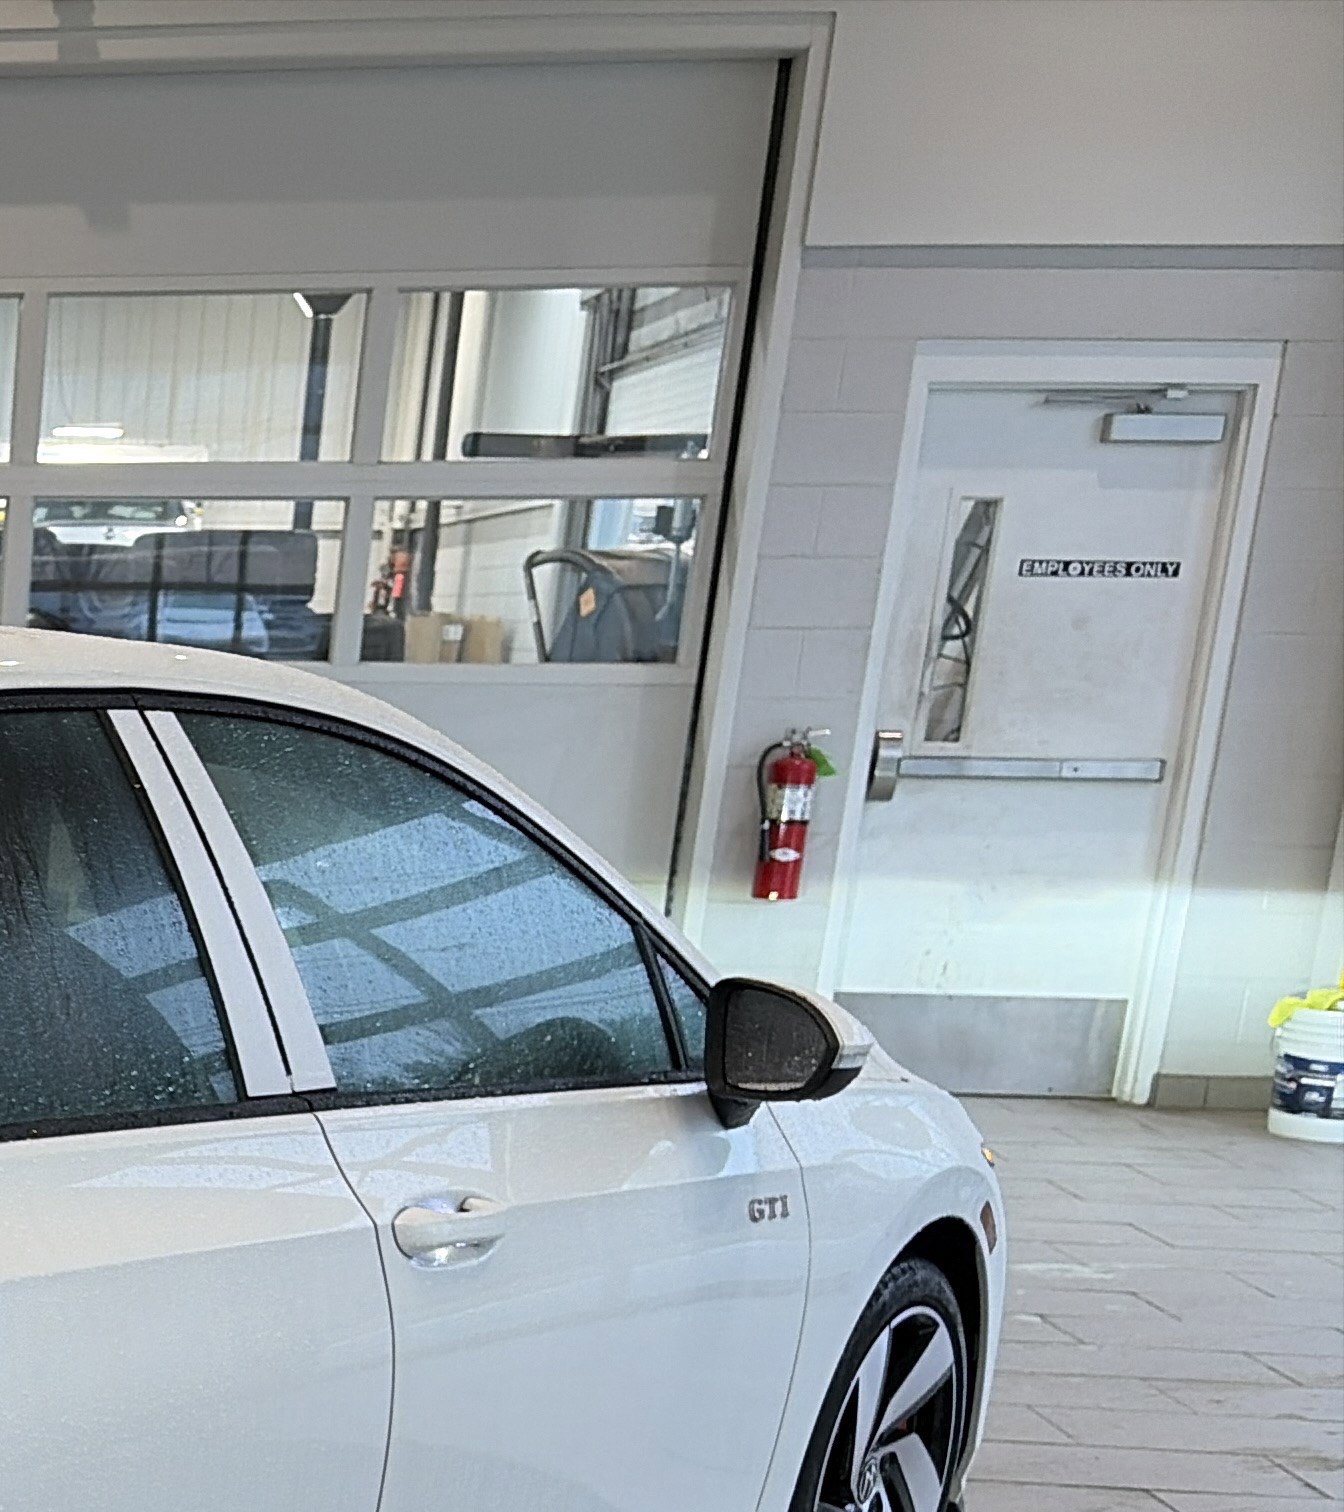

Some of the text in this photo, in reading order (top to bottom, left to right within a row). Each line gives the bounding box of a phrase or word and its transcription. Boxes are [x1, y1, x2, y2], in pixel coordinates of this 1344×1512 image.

[1021, 560, 1178, 577] EMPLOYEES ONLY
[748, 1194, 790, 1223] GTI
